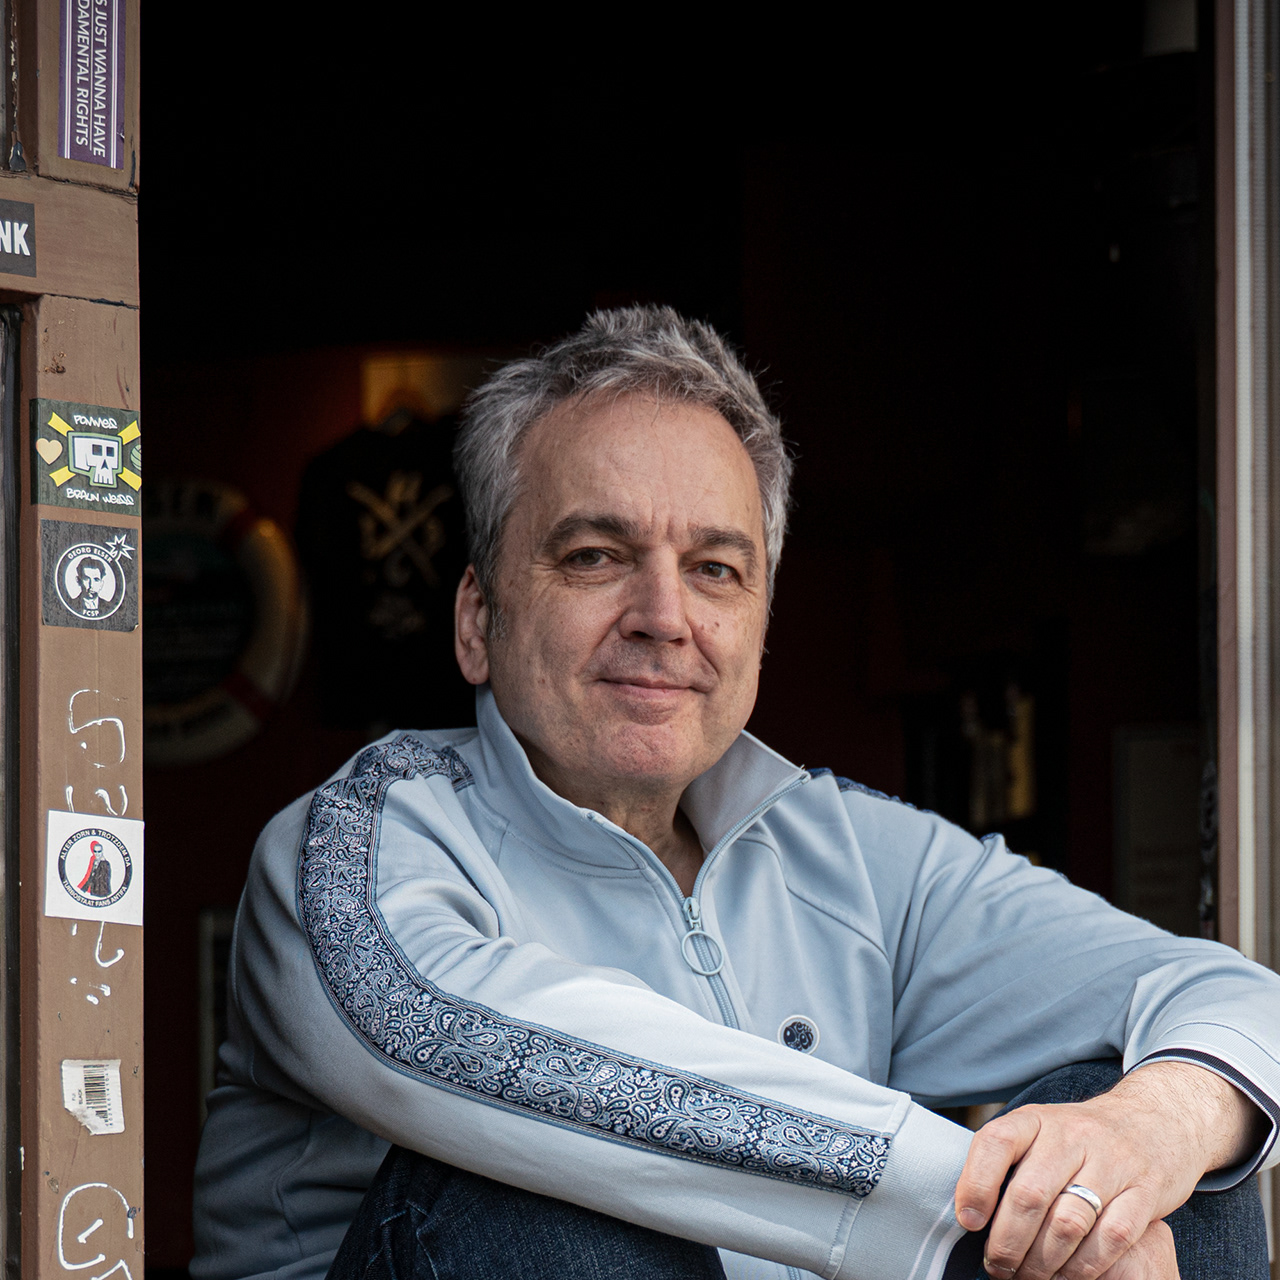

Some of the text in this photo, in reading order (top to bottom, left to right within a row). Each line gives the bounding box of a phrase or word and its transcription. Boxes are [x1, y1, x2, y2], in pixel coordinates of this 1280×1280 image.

[92, 7, 107, 158] JUST WANNA HAVE
[75, 87, 89, 146] RIGHTS
[67, 547, 114, 564] GEORG ELSER
[82, 609, 100, 617] FCSP
